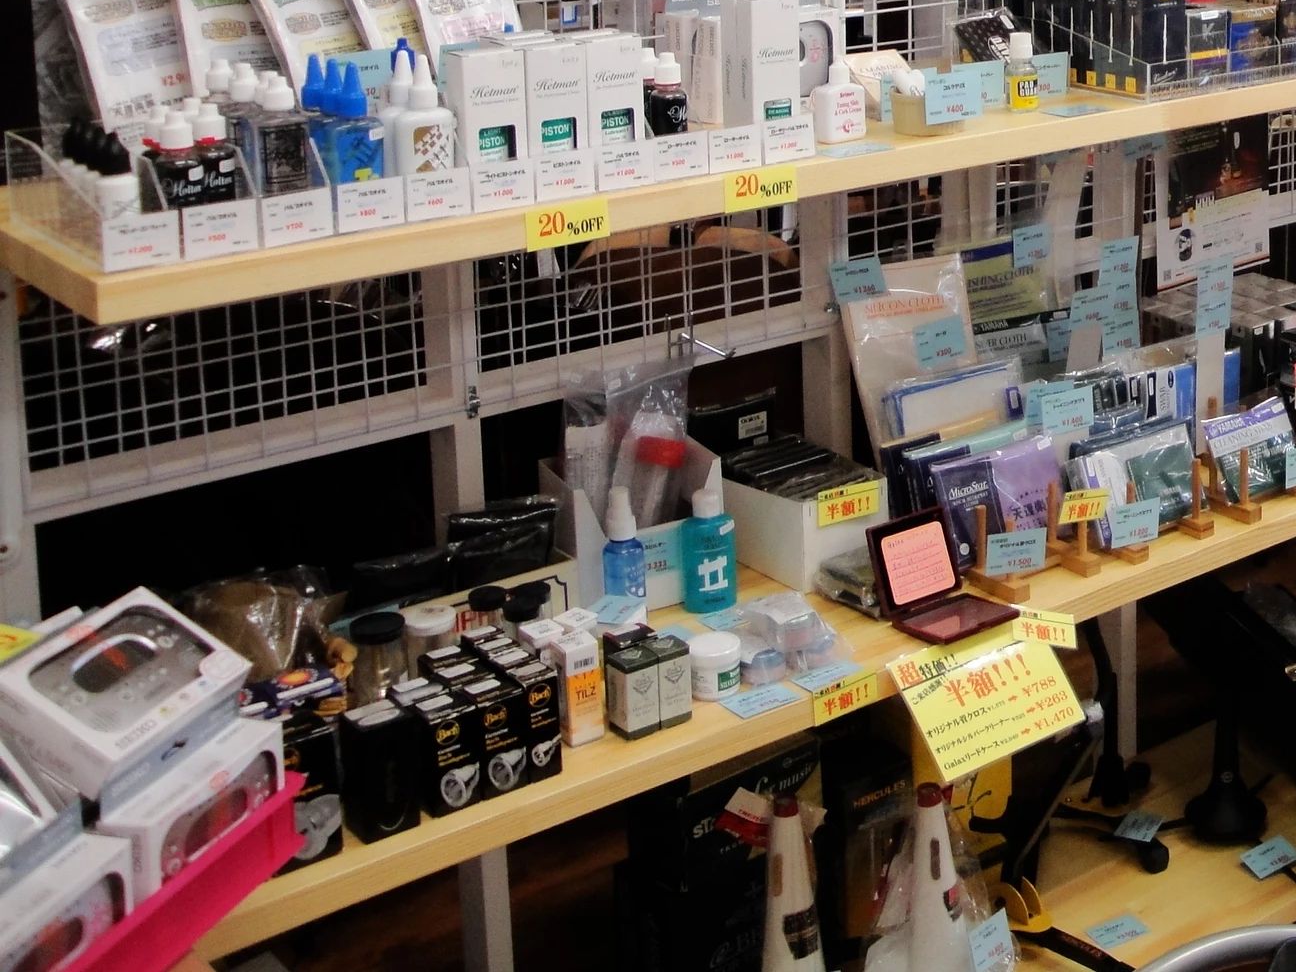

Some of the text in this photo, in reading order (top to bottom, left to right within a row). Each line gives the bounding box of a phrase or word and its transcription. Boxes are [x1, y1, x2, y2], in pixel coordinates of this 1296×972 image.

[946, 104, 964, 113] ¥400
[601, 115, 630, 128] PISTON
[540, 123, 570, 137] PISTON
[478, 135, 506, 149] PISTON
[575, 685, 596, 700] TILZ
[1021, 675, 1057, 697] ¥788
[1034, 690, 1069, 712] ¥263
[1033, 706, 1074, 731] ¥1,470
[853, 778, 907, 809] HERCULES
